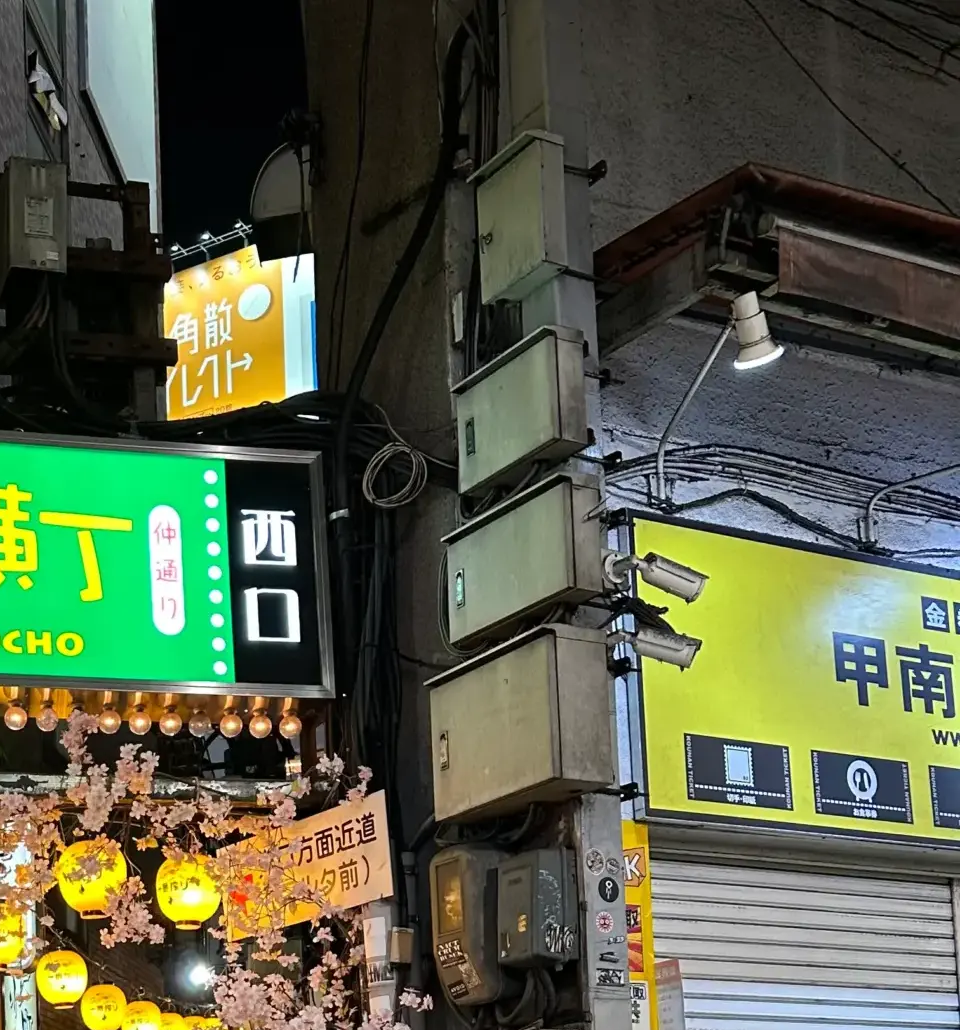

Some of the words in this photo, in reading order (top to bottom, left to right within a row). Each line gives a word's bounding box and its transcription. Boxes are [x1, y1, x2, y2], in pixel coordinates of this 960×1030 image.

[153, 520, 178, 620] 仲通り
[240, 508, 302, 643] 西口
